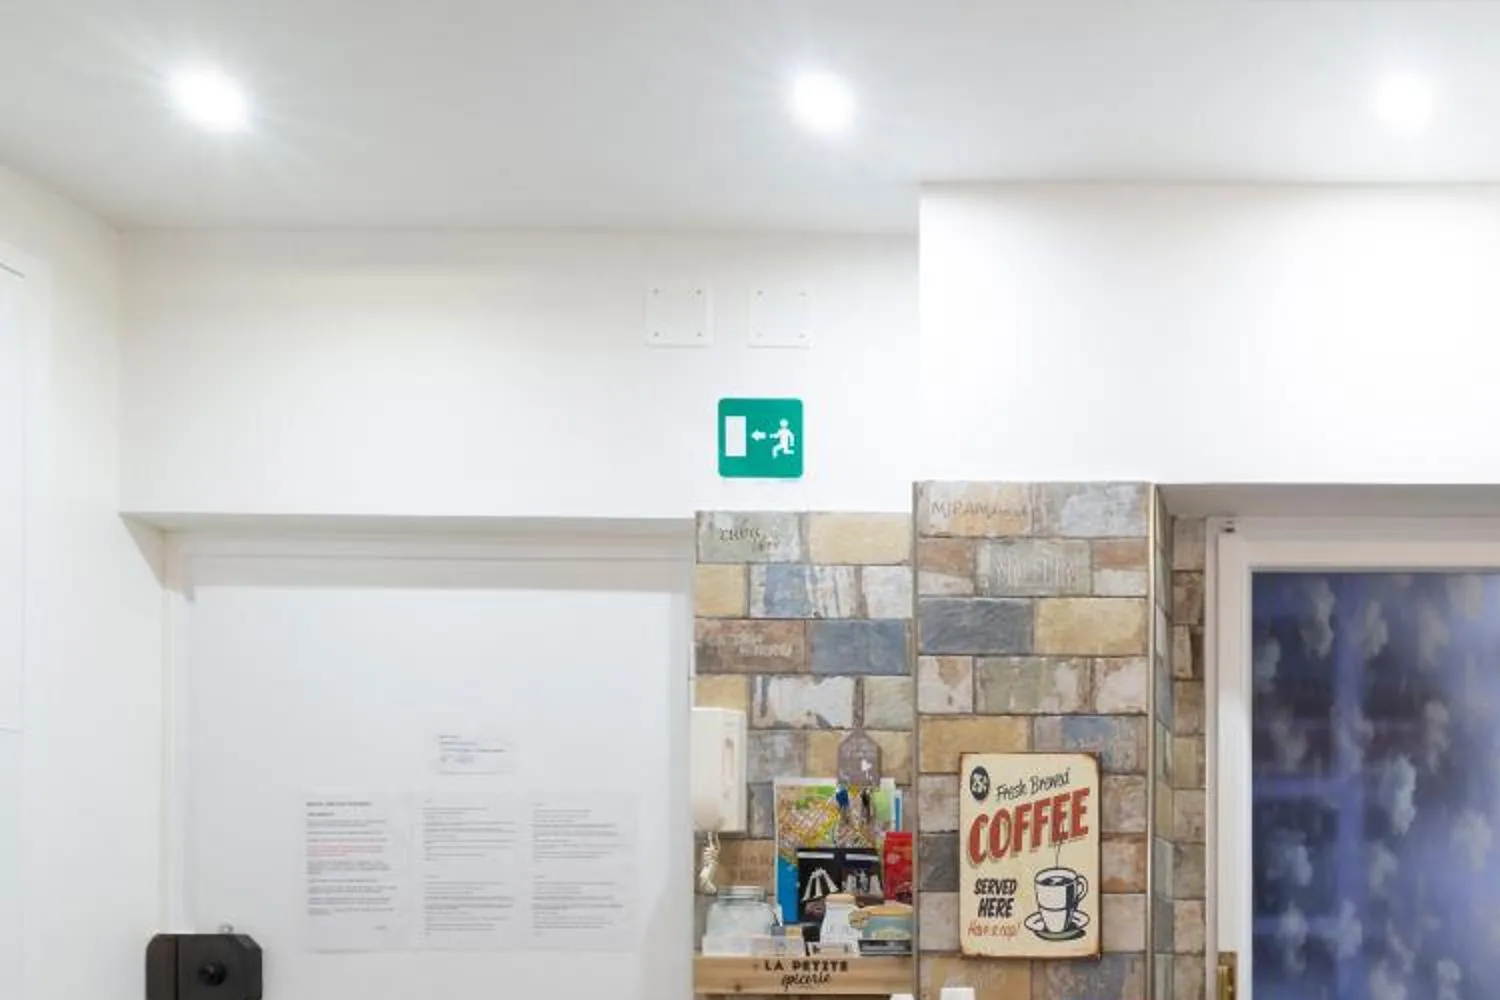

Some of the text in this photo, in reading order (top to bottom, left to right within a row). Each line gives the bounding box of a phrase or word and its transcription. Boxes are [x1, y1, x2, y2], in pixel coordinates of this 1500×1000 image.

[995, 767, 1071, 801] Fresh Brewed
[967, 788, 1091, 867] COFFEE
[973, 877, 1018, 896] SERVED
[977, 897, 1016, 919] HERE
[764, 959, 849, 973] LA PETITE
